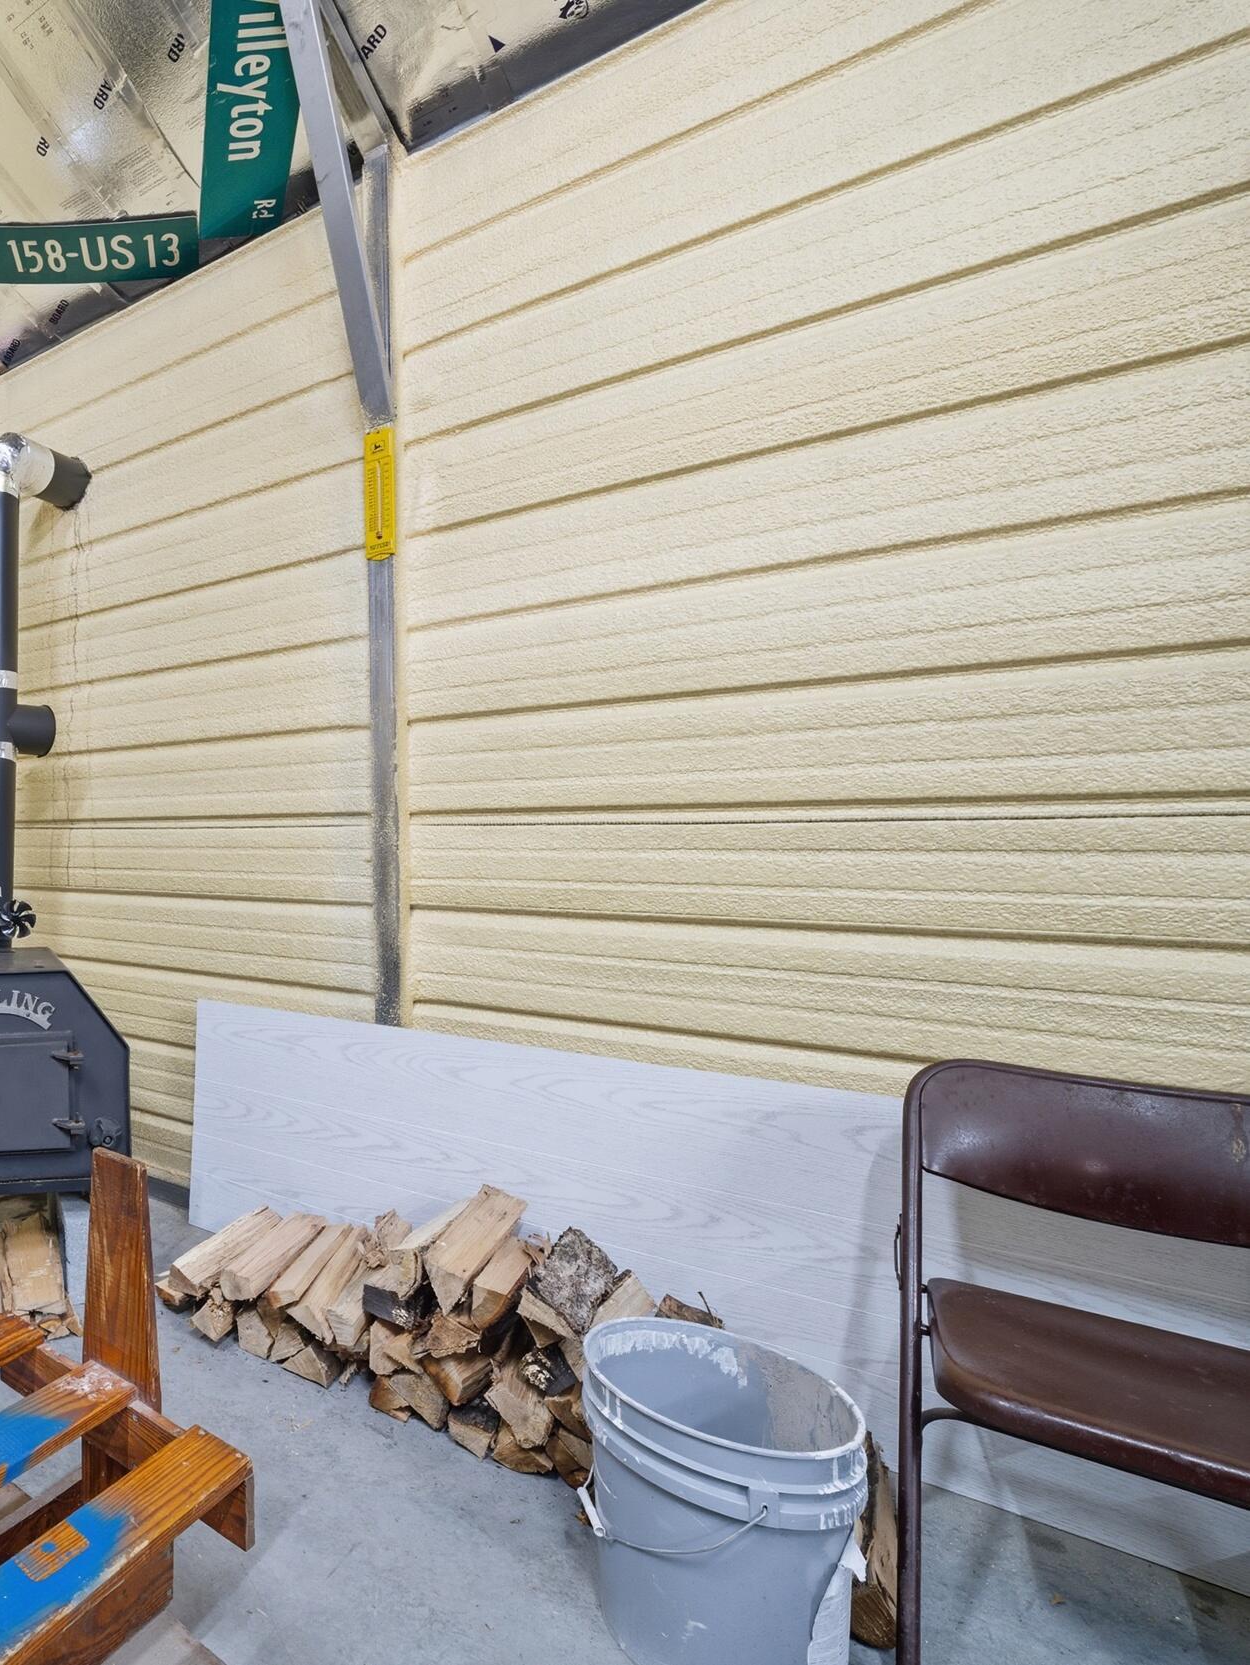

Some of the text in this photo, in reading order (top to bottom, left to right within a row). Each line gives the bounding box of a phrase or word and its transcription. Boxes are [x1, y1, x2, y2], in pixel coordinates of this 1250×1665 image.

[216, 0, 289, 162] illeyton
[252, 199, 277, 219] Rd
[6, 234, 136, 274] 158-US
[142, 233, 181, 268] 13
[49, 299, 70, 325] BOARD
